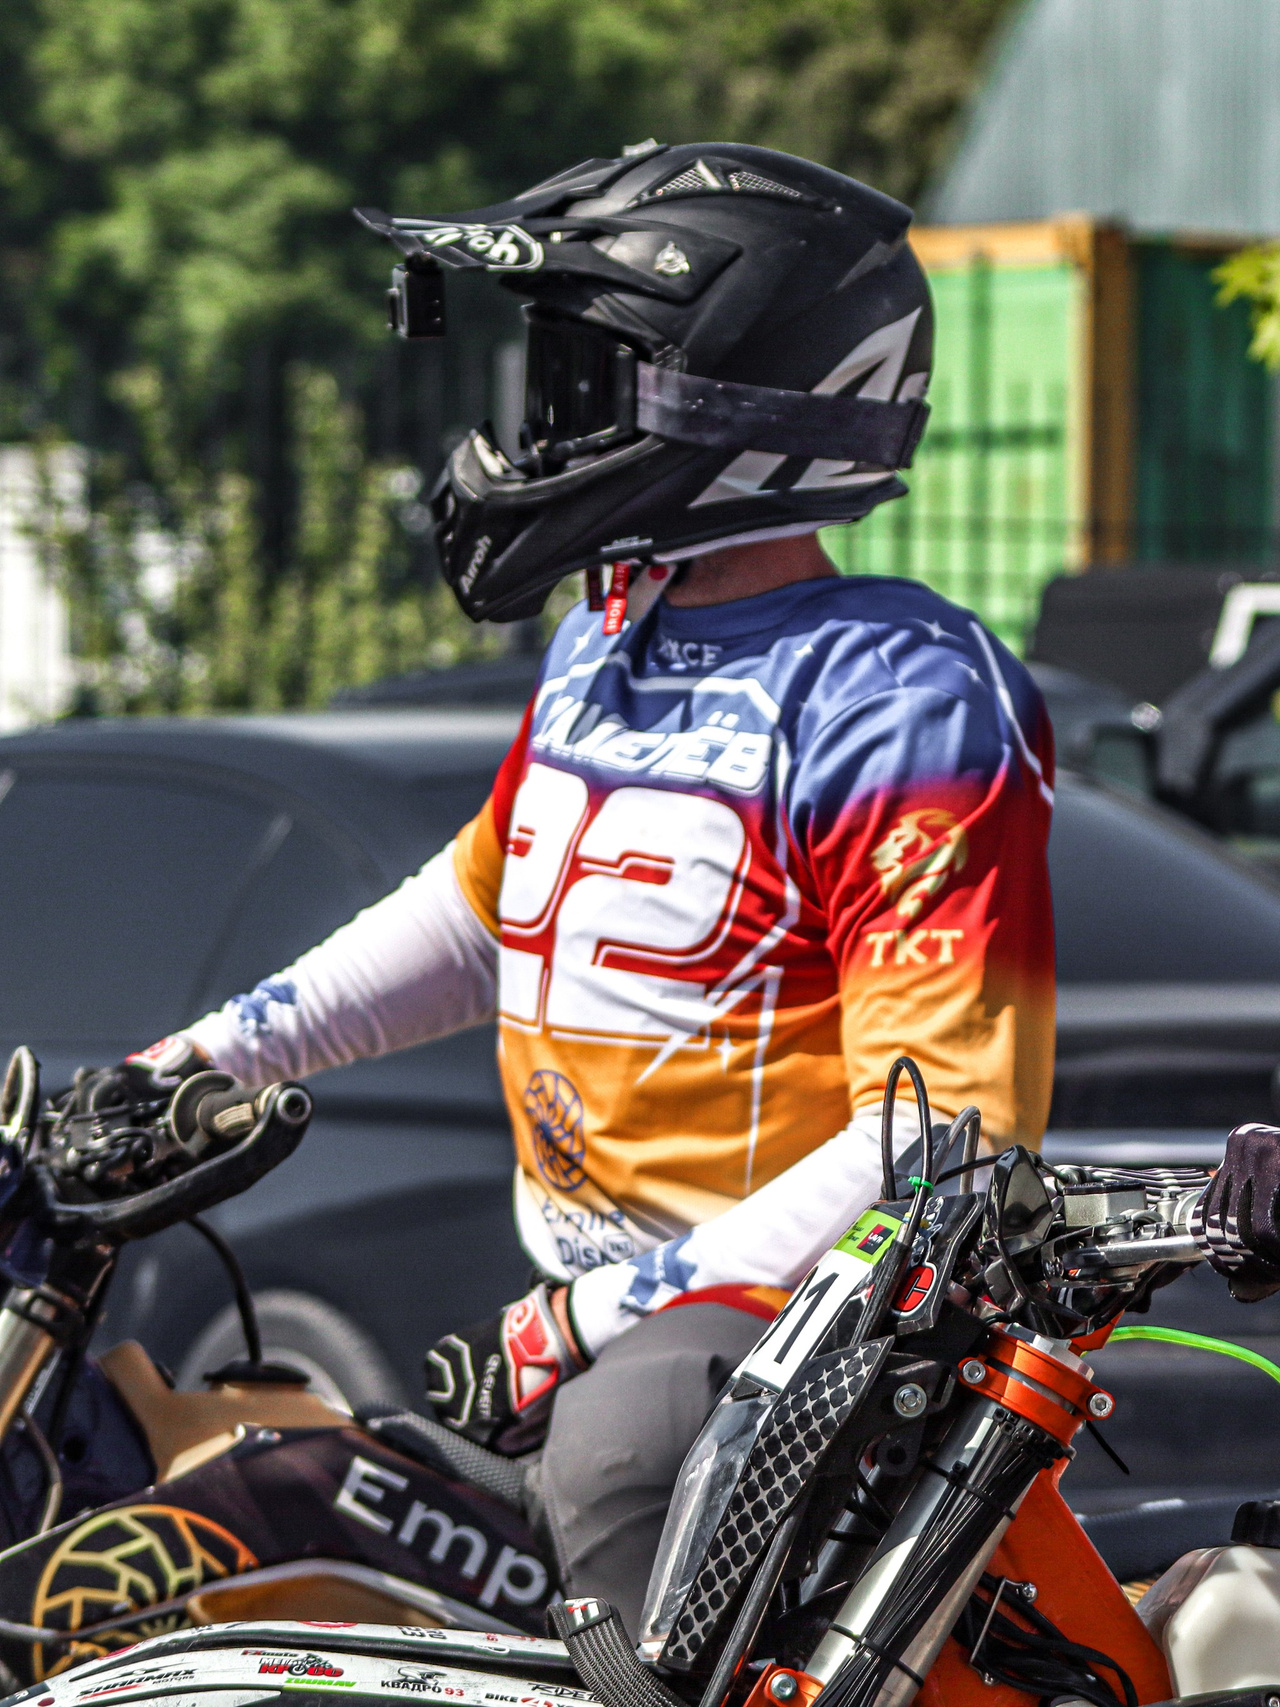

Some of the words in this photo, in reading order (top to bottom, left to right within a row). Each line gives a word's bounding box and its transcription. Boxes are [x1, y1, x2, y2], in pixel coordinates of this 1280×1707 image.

[867, 929, 964, 967] TKT
[333, 1454, 565, 1608] Emp
[284, 1677, 357, 1688] ZUUMAV
[381, 1679, 442, 1694] КВАДРО
[444, 1687, 465, 1697] 93
[484, 1692, 519, 1703] BIKE
